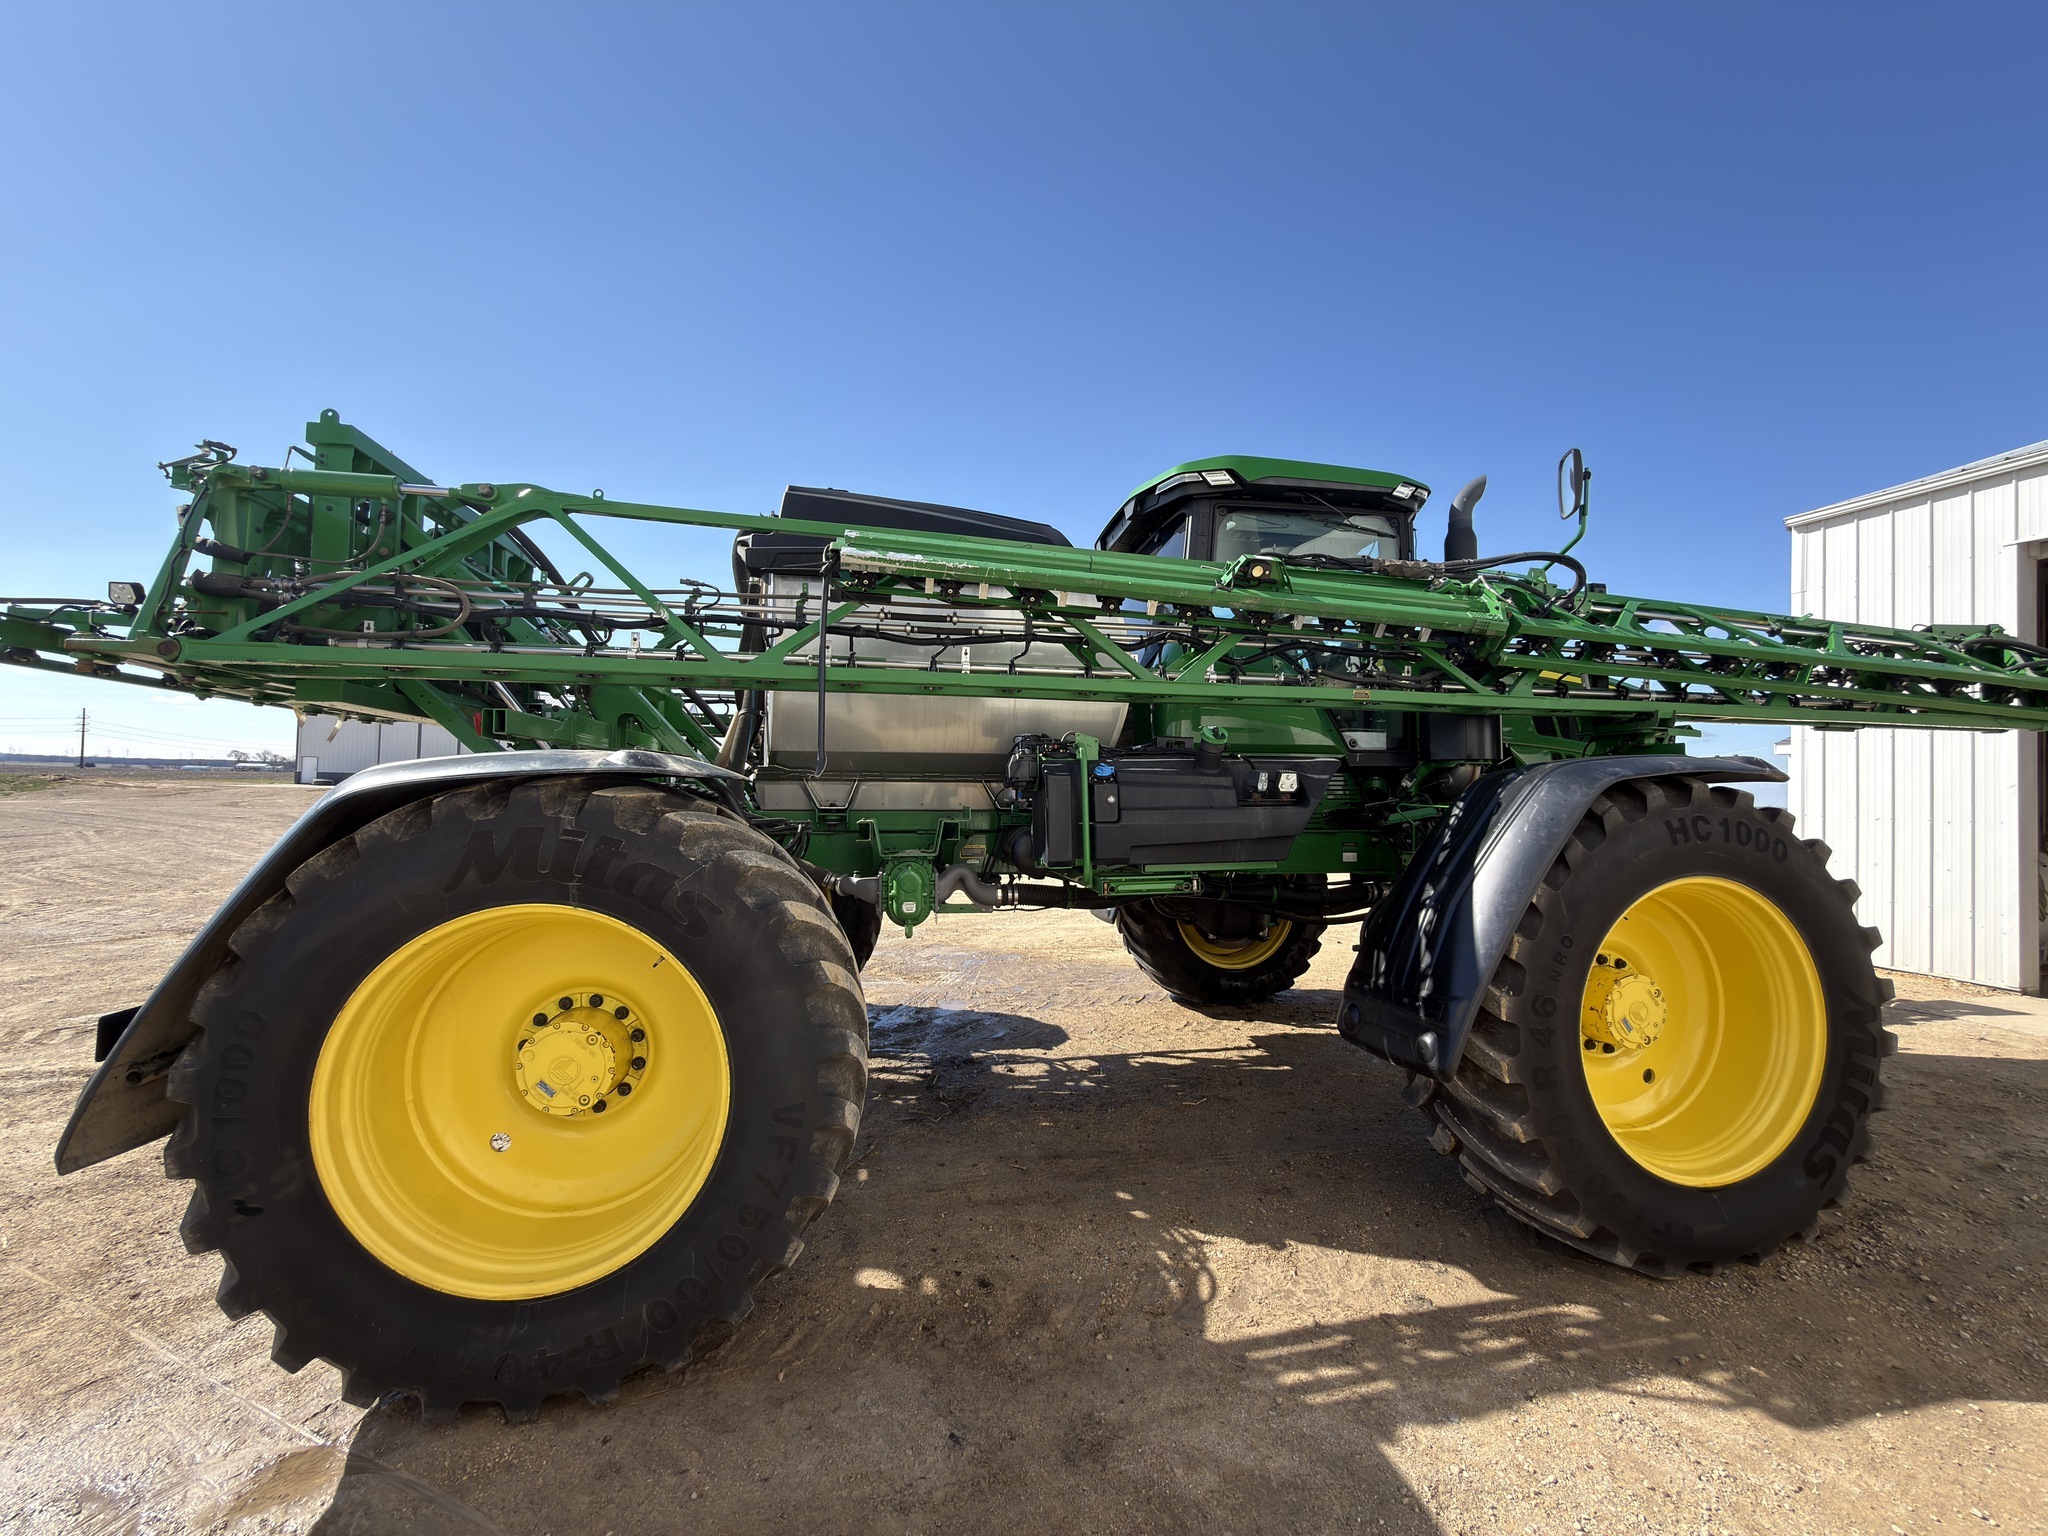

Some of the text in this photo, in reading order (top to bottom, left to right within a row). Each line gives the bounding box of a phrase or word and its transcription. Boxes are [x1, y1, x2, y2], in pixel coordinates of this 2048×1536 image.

[441, 826, 724, 939] Mitas
[1663, 815, 1788, 863] HC 1000
[1802, 982, 1877, 1190] Mitas
